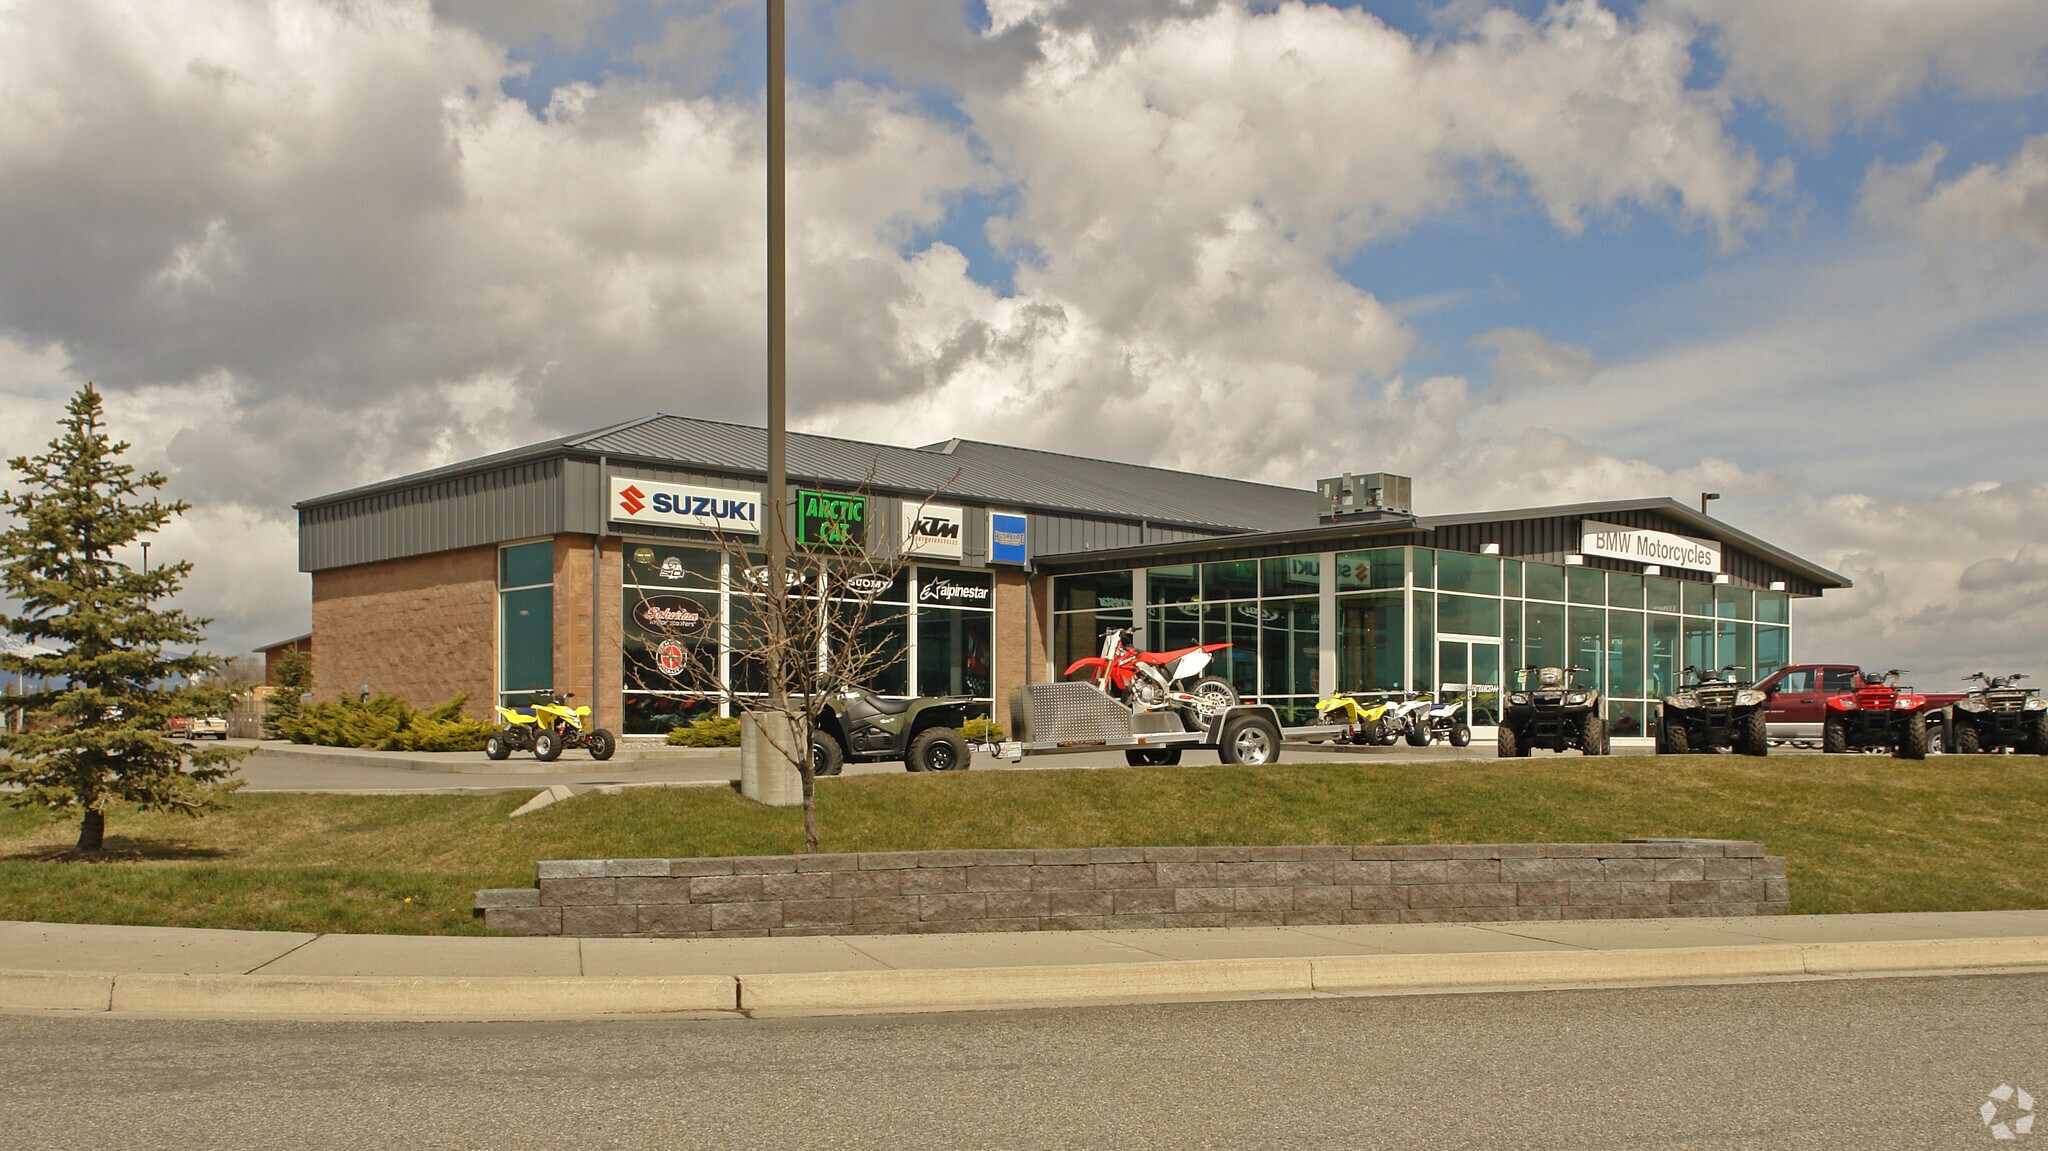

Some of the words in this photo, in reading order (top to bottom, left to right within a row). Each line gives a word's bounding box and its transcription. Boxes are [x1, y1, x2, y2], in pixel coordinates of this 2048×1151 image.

[652, 493, 755, 521] SUZUKI
[806, 498, 863, 521] ARCTIC
[820, 521, 850, 542] CAT
[910, 516, 959, 539] KTM
[1596, 531, 1632, 553] BMW
[1637, 535, 1712, 566] Motorcycles
